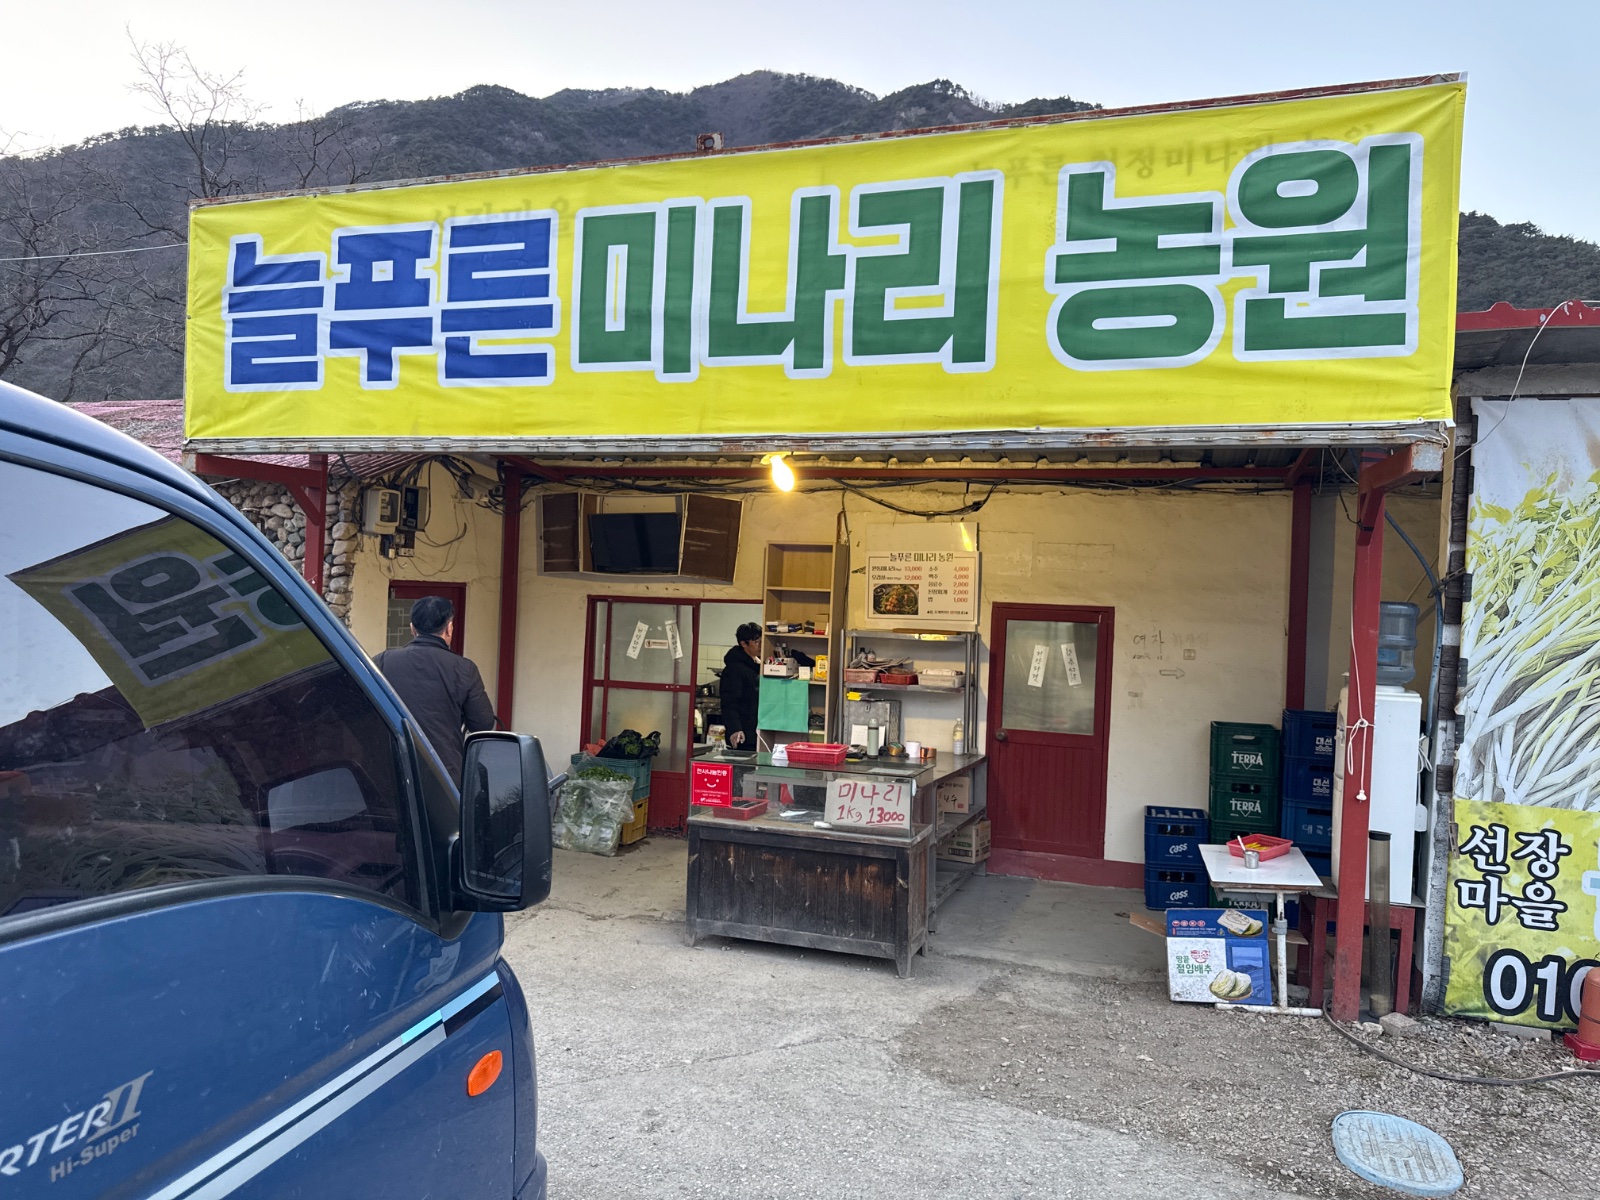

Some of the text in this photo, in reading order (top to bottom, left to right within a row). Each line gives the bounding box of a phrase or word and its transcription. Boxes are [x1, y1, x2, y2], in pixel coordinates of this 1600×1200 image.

[223, 132, 1424, 392] 늘푸른 미나리 농원
[890, 552, 954, 562] 늘푸른 미나리 농원
[837, 782, 903, 806] 미나리
[865, 805, 906, 825] 13000
[1458, 822, 1573, 881] 선장
[1454, 873, 1569, 931] 마을
[1175, 963, 1212, 975] 절임배추
[49, 1123, 140, 1183] Hi-Super
